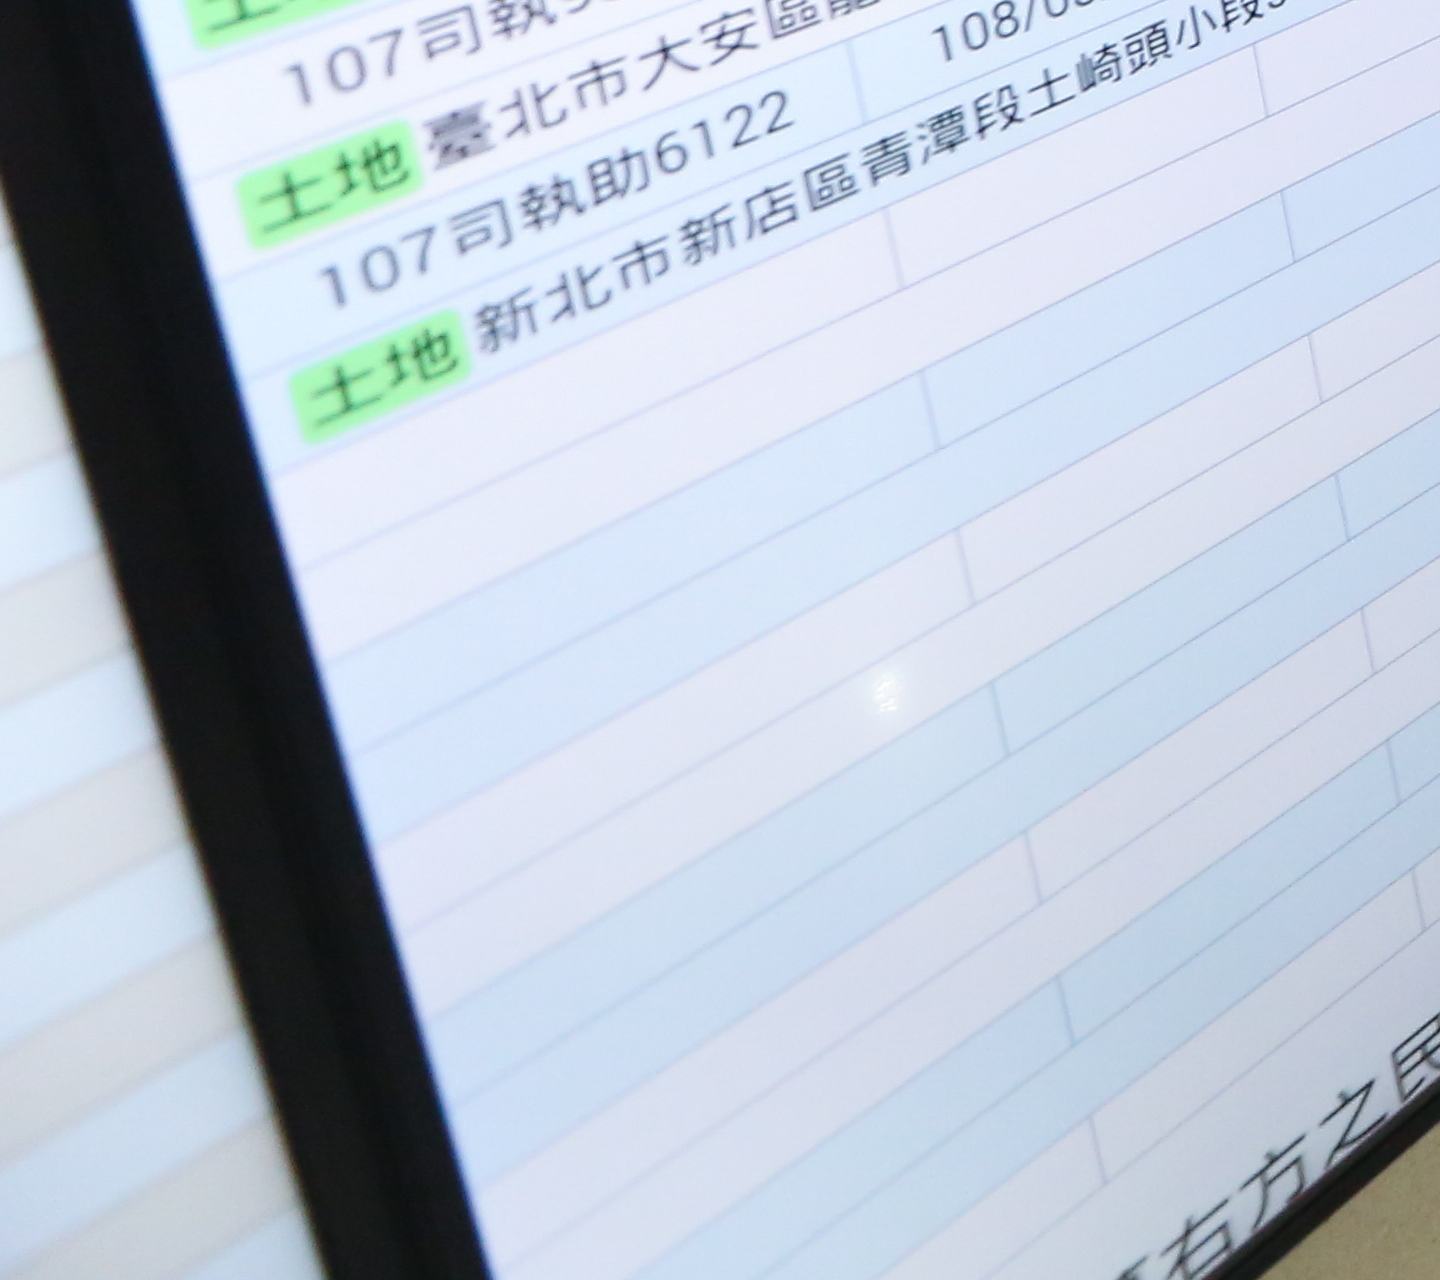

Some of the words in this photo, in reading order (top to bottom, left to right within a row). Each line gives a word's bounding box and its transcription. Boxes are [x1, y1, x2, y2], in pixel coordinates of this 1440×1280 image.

[256, 135, 410, 235] 土地
[319, 87, 797, 310] 107司執助6122
[309, 325, 459, 430] 土地
